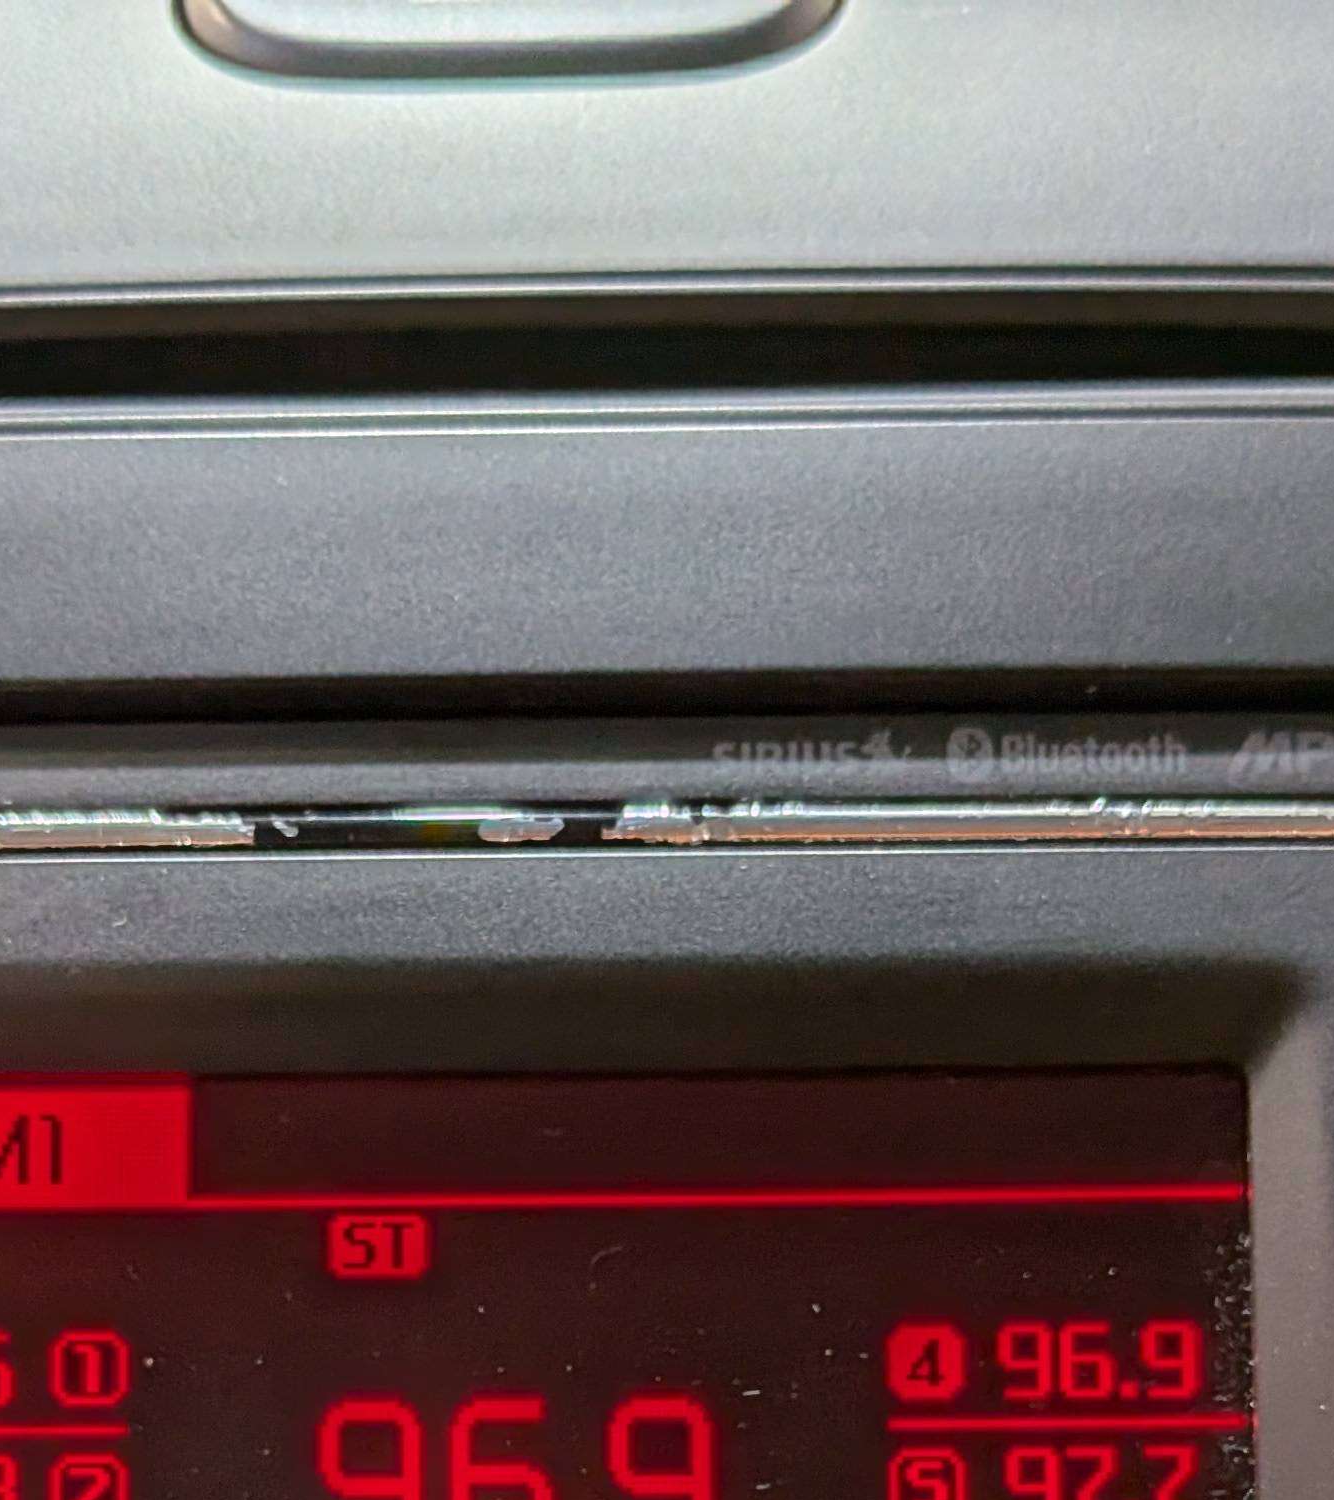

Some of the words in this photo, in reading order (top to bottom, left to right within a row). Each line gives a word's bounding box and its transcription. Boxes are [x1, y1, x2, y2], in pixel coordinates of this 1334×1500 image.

[999, 734, 1187, 774] Bluetooth
[340, 1222, 416, 1271] ST
[995, 1321, 1205, 1400] 96.9
